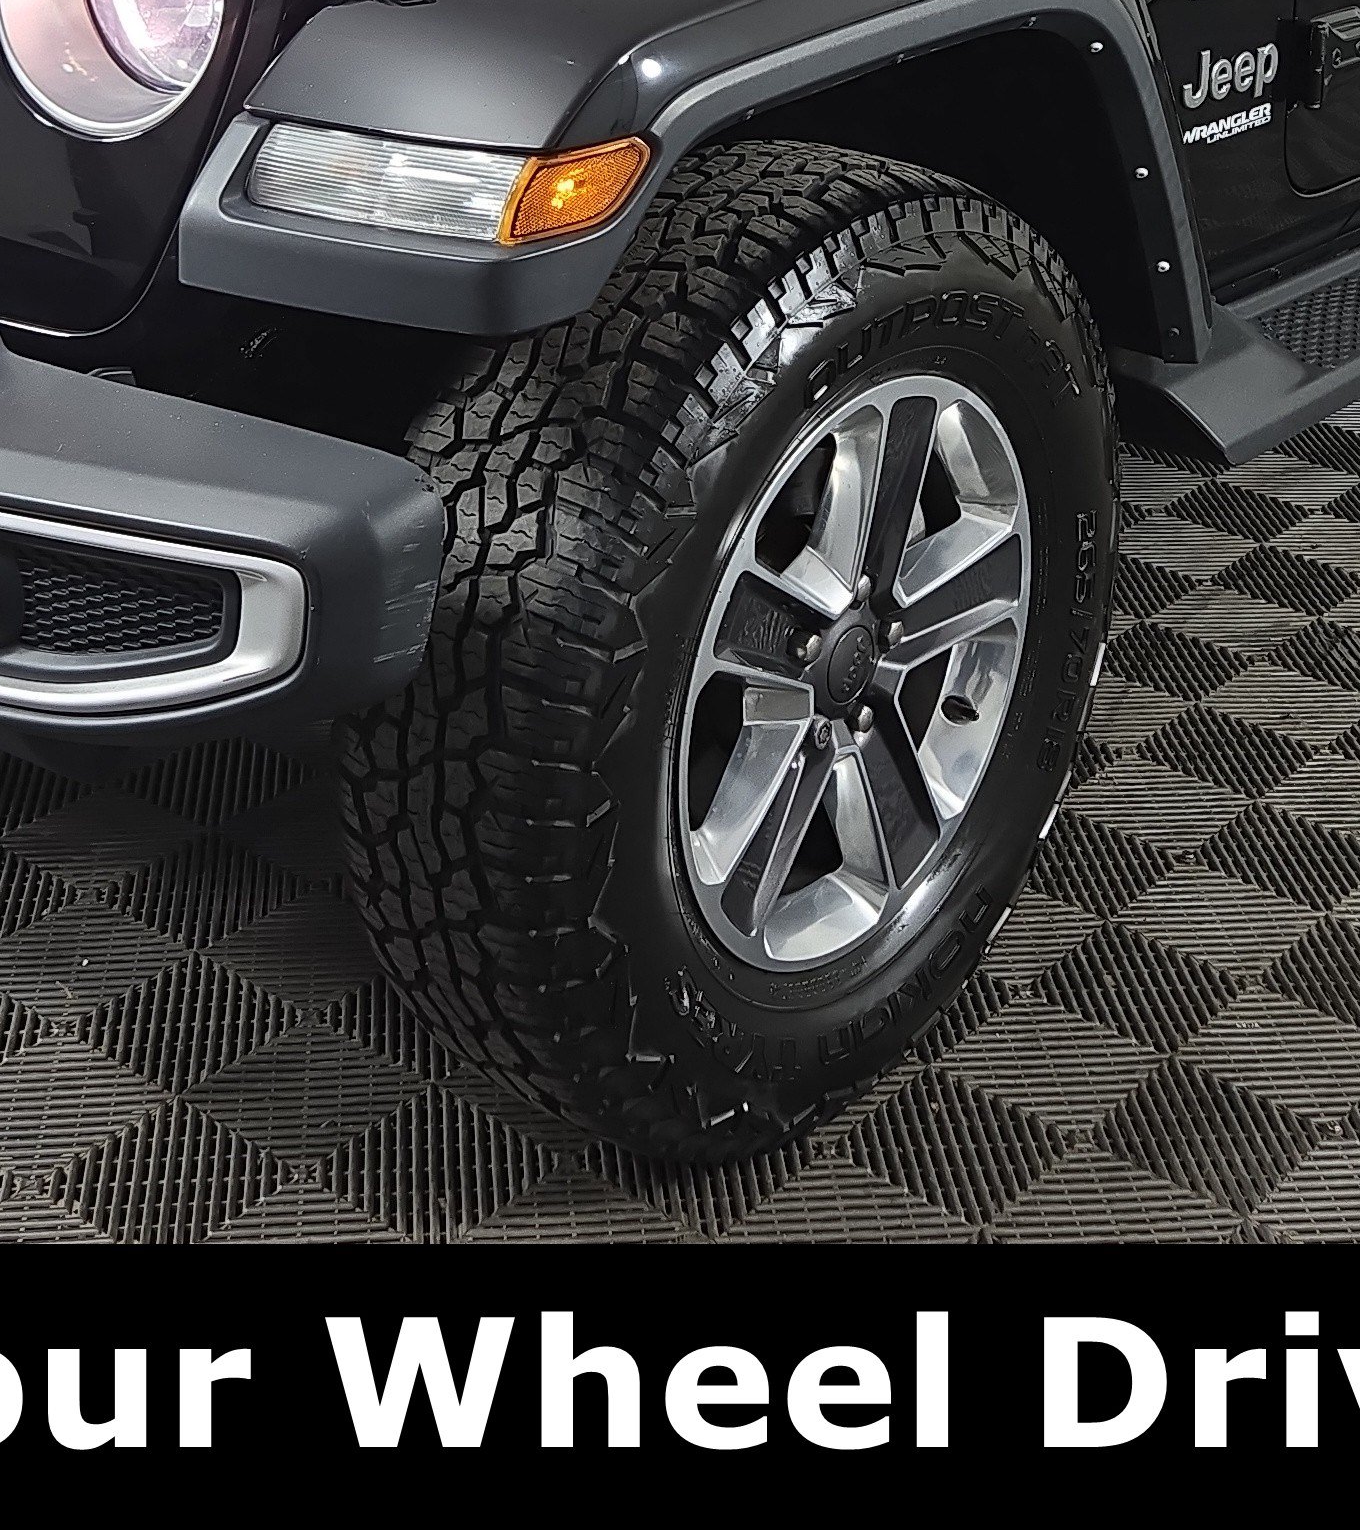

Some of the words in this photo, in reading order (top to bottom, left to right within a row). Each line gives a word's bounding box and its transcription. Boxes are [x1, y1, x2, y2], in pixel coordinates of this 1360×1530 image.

[1182, 42, 1279, 109] Jeep
[1183, 101, 1272, 145] WRANGLER
[1206, 115, 1272, 145] UNLIMITED
[803, 289, 1026, 410] OUTPOST
